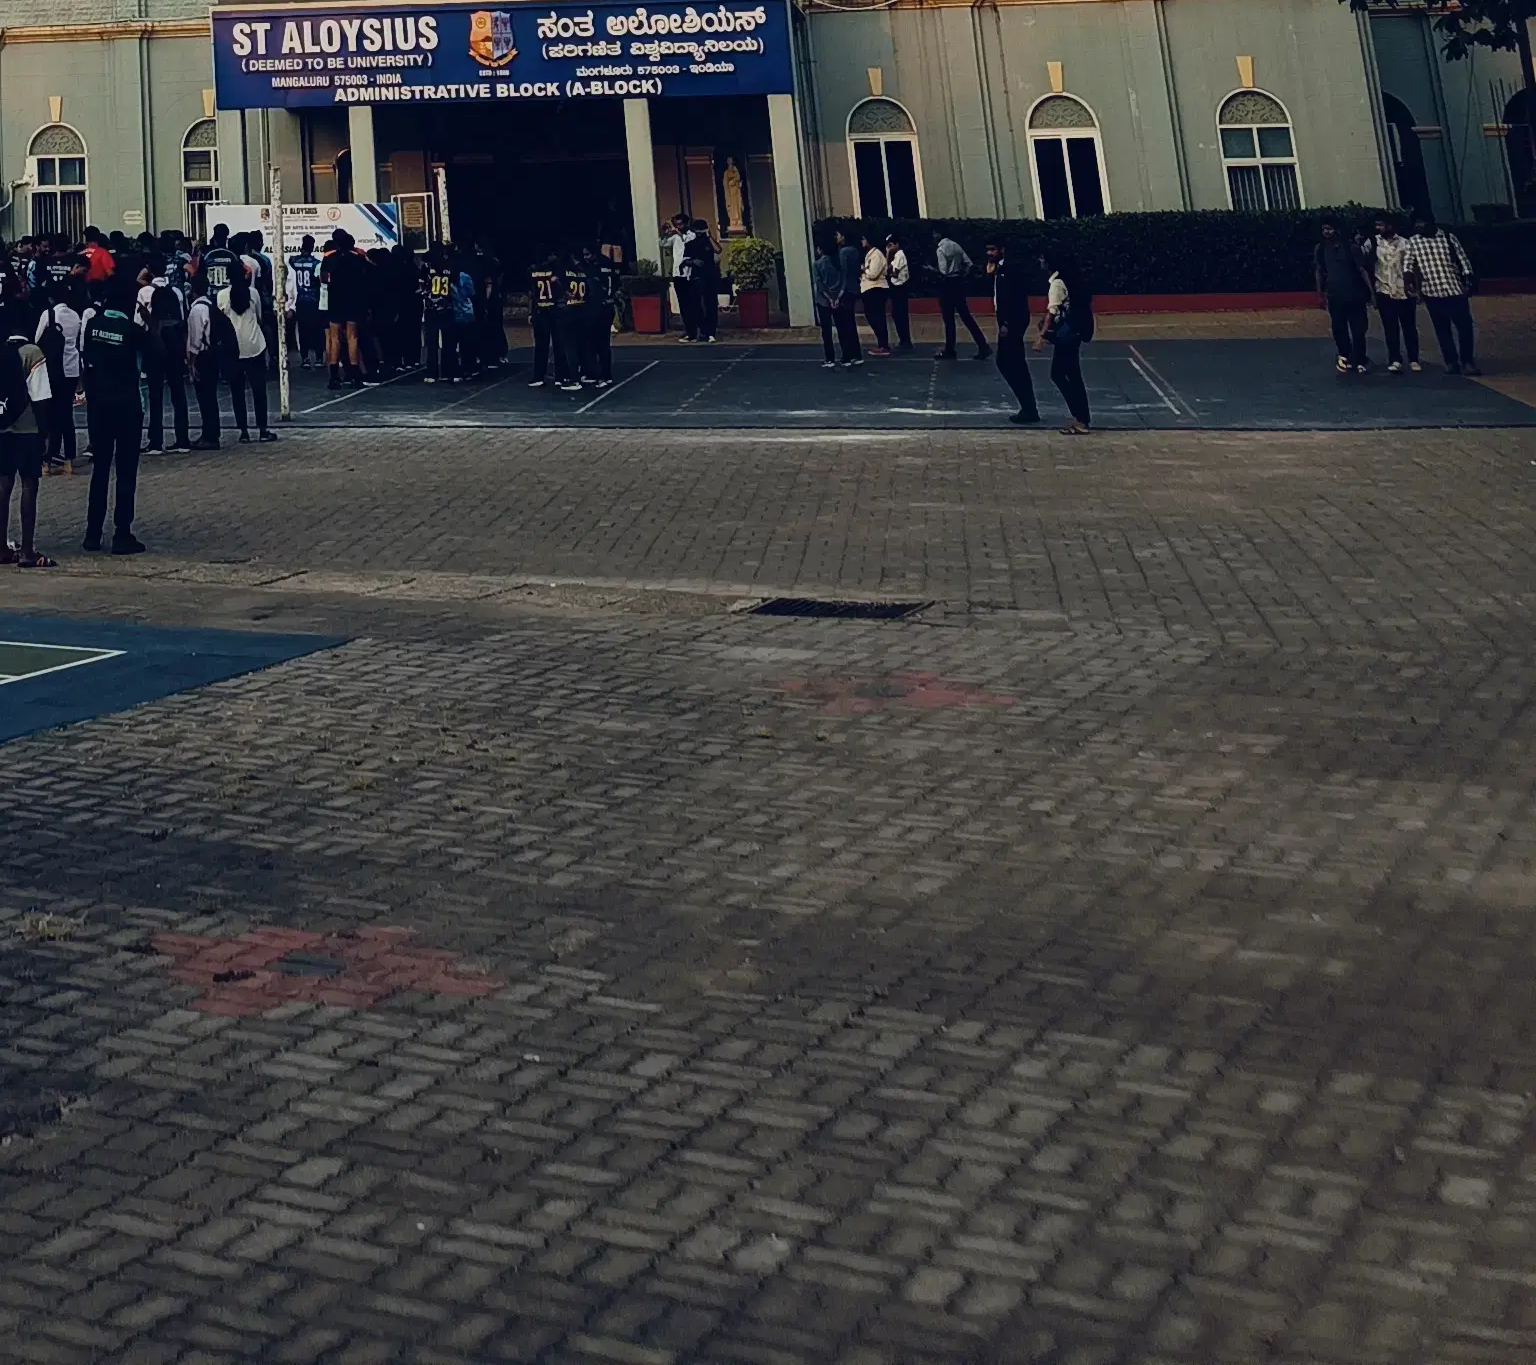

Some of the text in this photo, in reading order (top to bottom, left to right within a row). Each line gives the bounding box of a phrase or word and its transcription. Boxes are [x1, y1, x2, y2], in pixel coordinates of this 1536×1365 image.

[537, 5, 766, 39] ಸಂತ ಅಲೋಶಿಯಸ್
[232, 15, 439, 56] ST ALOYSIUS
[306, 57, 324, 69] TO
[327, 56, 345, 69] BE
[637, 64, 680, 75] 575003
[271, 75, 330, 88] MANGALURU
[334, 75, 368, 86] 575003
[376, 73, 402, 84] INDIA
[334, 78, 663, 102] ADMINISTRATIVE BLOCK (A-BLOCK)
[431, 276, 449, 296] 03
[537, 280, 553, 300] 21
